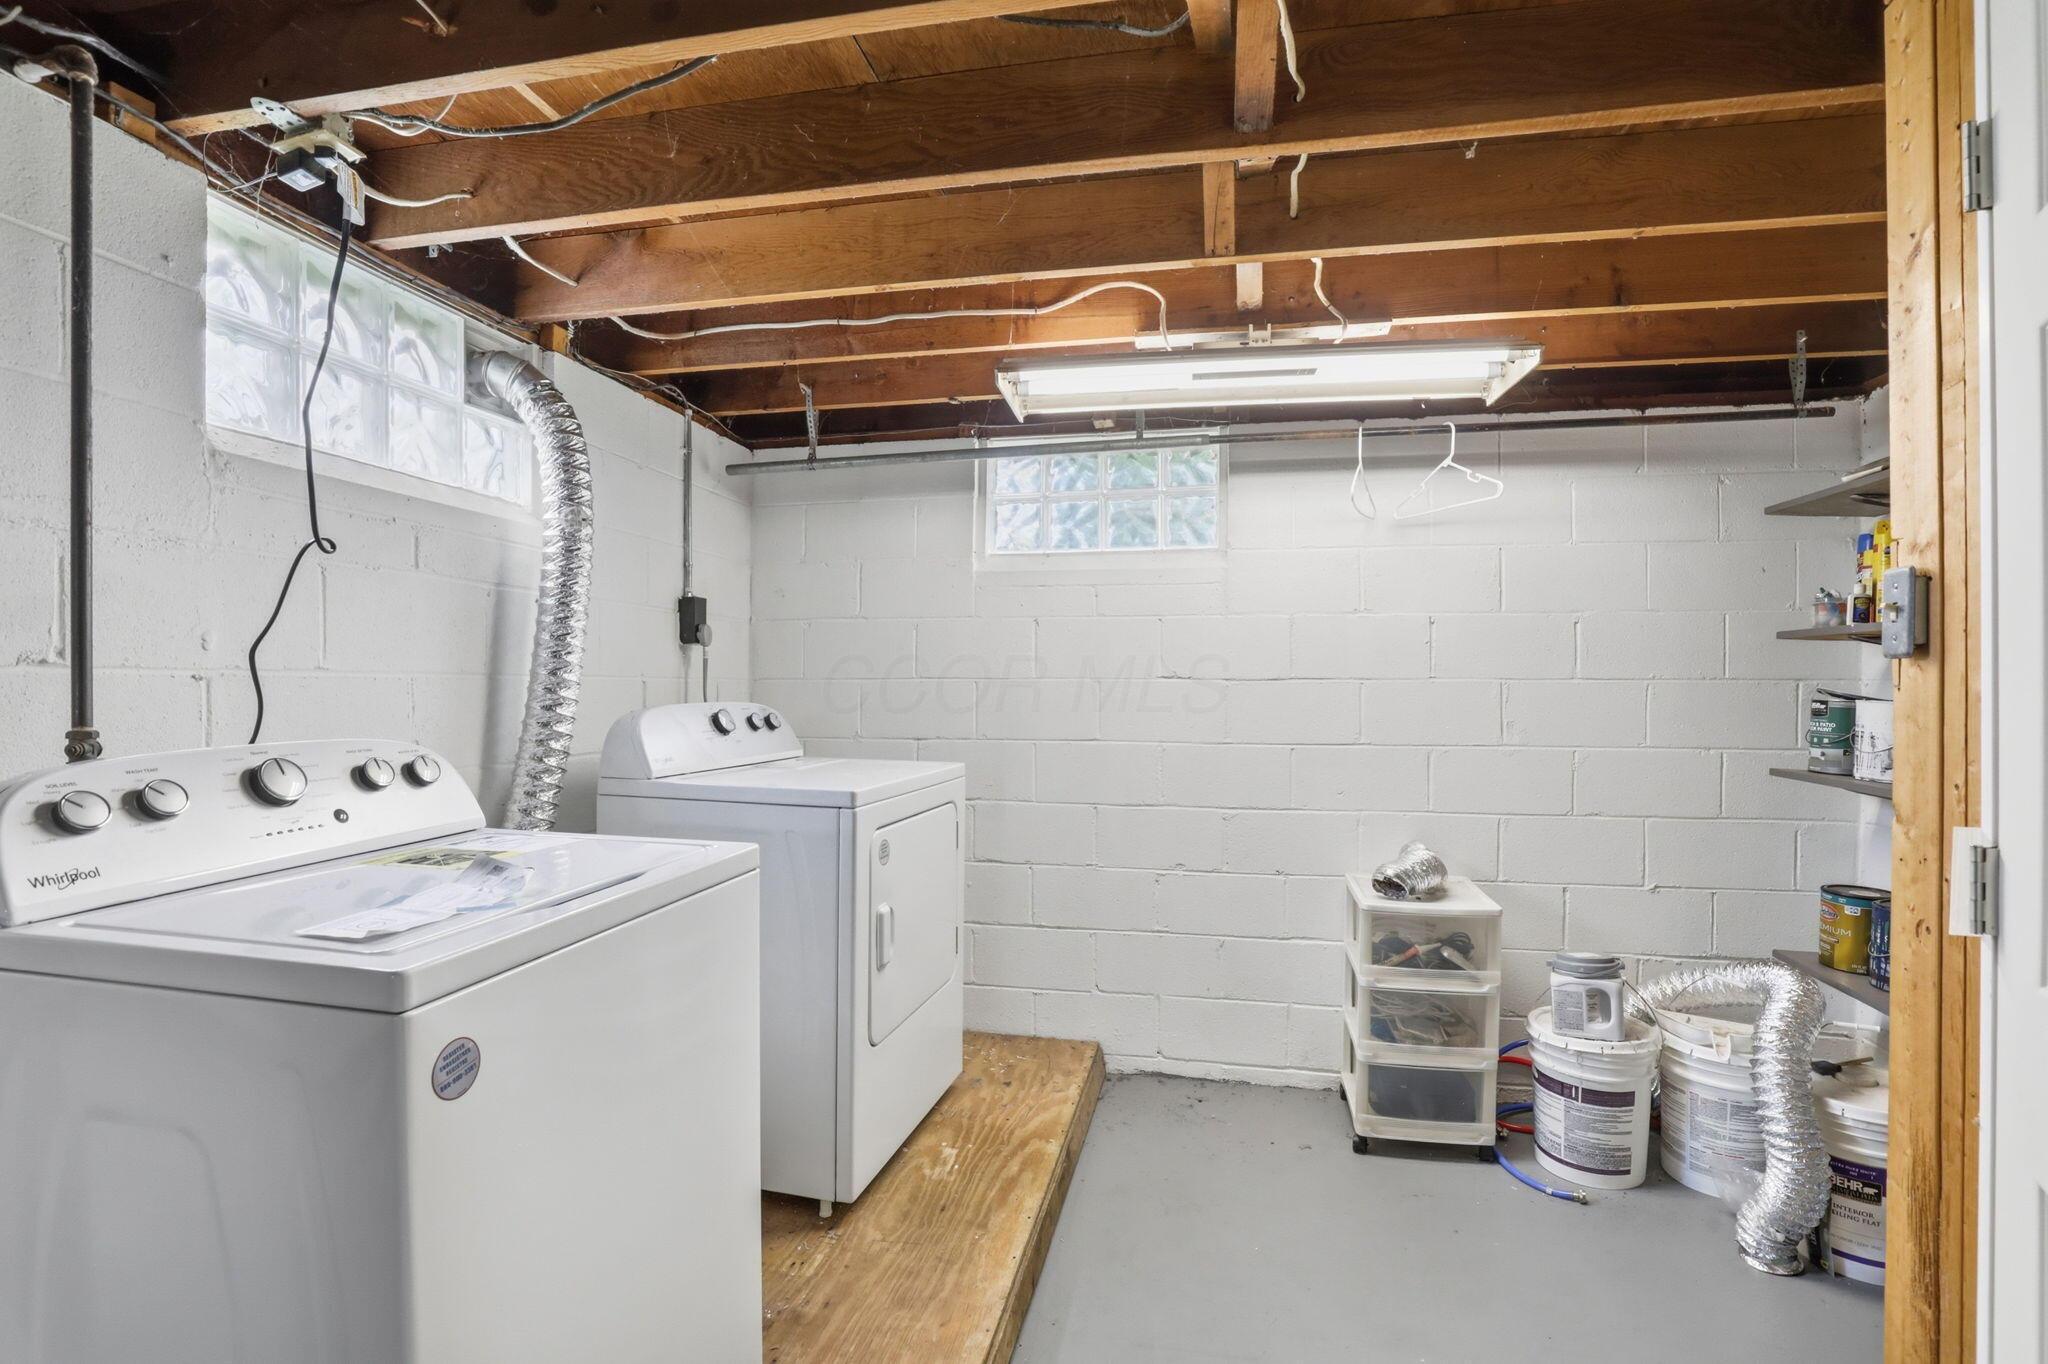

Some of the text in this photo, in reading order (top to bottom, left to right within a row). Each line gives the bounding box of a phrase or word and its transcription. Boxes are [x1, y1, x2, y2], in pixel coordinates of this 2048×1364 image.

[27, 866, 101, 891] Whirlpool
[1829, 1174, 1863, 1192] BEHR
[1831, 1209, 1881, 1228] EILING FLAT
[1833, 1202, 1875, 1219] INTERIOR
